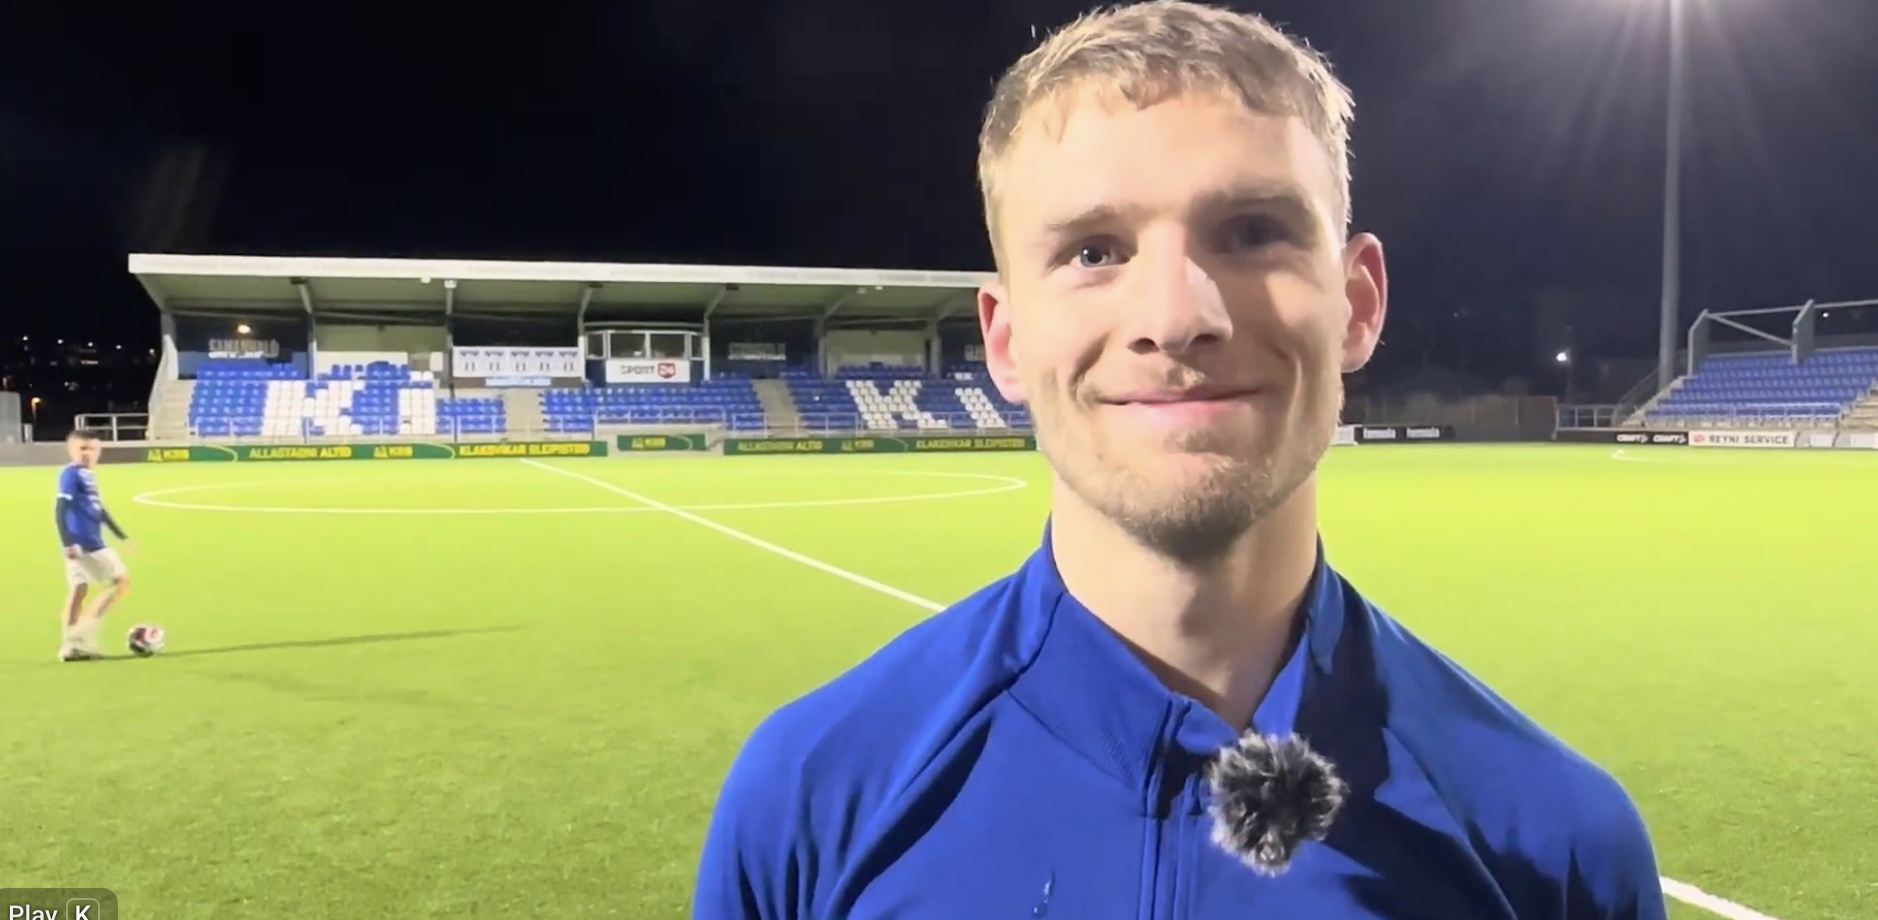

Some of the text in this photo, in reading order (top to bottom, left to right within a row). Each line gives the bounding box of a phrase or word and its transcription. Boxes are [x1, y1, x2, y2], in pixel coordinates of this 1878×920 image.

[620, 365, 655, 375] SPORT
[1709, 435, 1789, 445] REYNI SERVICE
